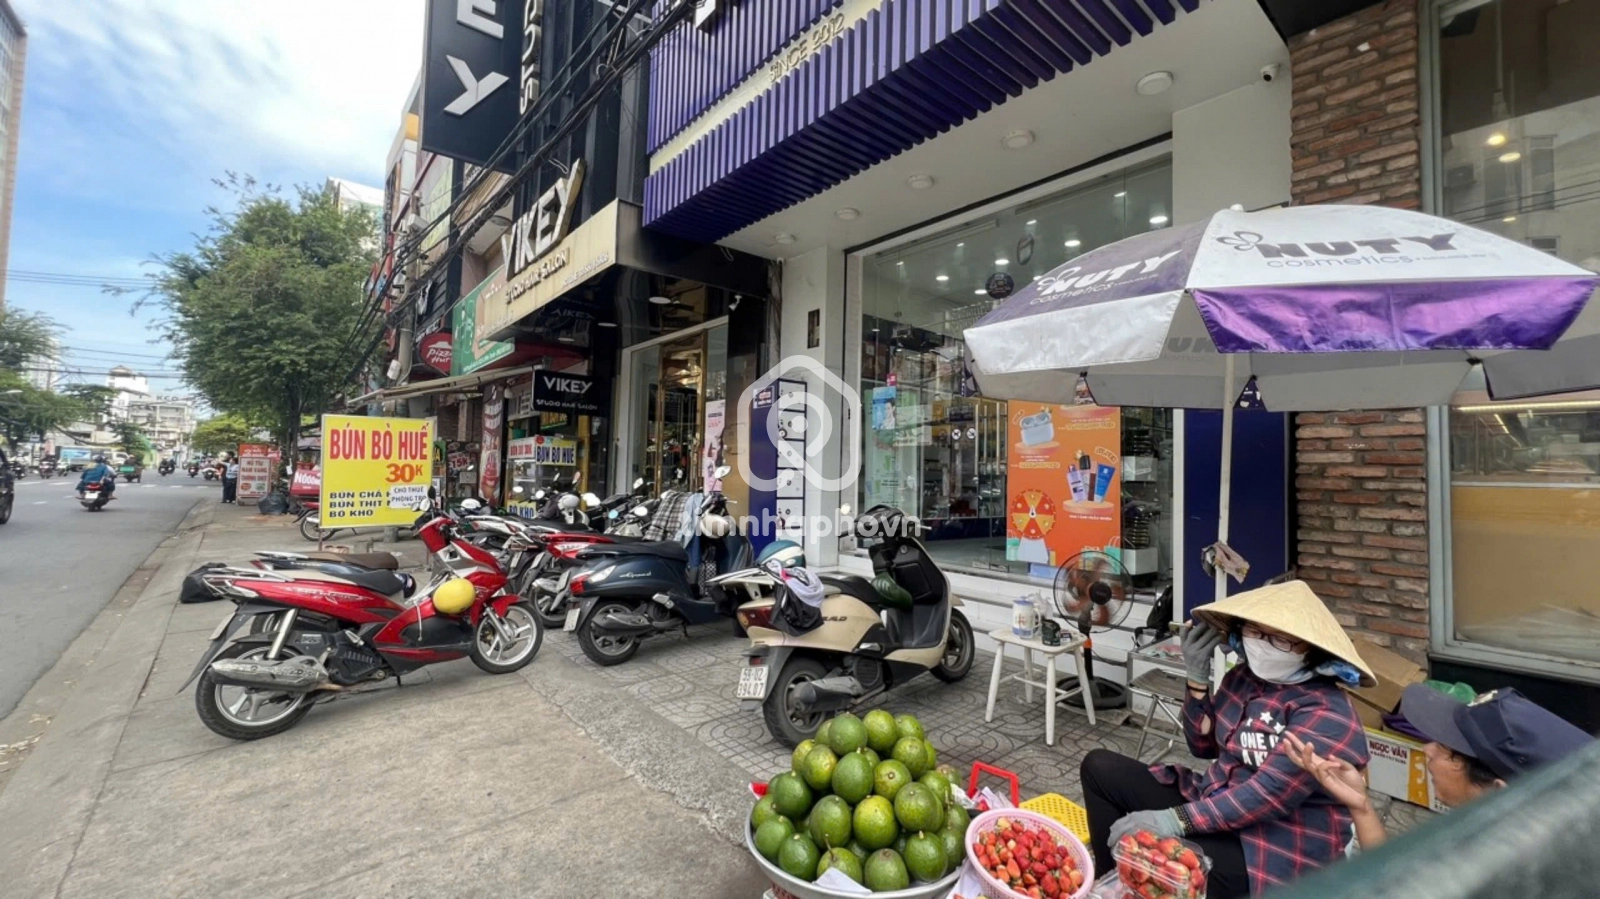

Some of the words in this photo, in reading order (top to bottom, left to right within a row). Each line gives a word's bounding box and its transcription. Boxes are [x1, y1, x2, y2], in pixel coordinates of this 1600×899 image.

[769, 39, 808, 82] SINCE
[812, 13, 845, 51] 2012
[501, 157, 580, 283] VIKEY
[1255, 232, 1458, 259] NUTY
[1040, 249, 1183, 296] NUTY
[1266, 256, 1415, 269] cosmetics
[1030, 284, 1116, 306] cosmetics
[543, 375, 593, 394] VIKEY
[536, 399, 561, 407] STUDIO
[329, 422, 366, 460] BÚN
[371, 422, 393, 460] BÒ
[398, 422, 429, 461] HUẾ
[385, 463, 424, 483] 30K
[349, 509, 374, 517] KHO
[1240, 731, 1268, 750] ONE
